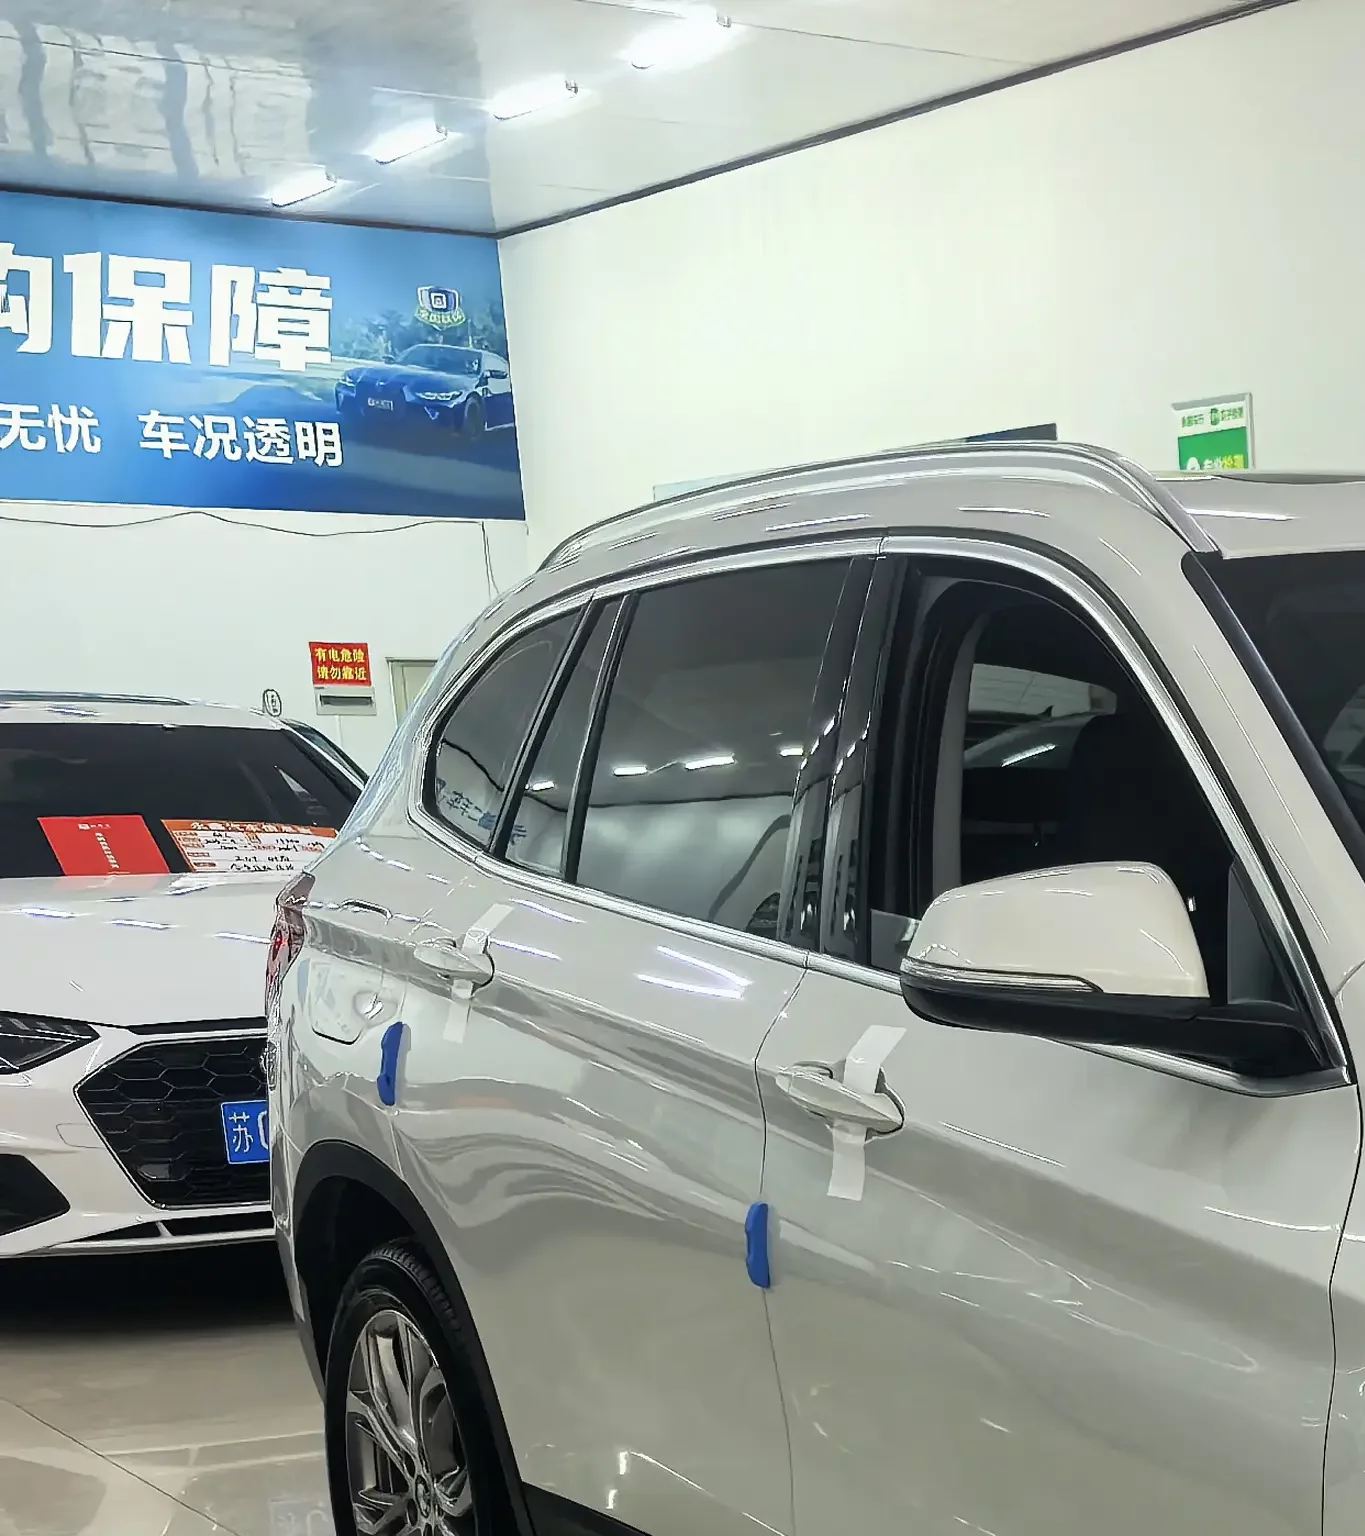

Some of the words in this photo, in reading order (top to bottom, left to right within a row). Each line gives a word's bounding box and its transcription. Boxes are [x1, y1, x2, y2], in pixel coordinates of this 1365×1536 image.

[137, 409, 345, 468] 车况透明
[314, 647, 365, 664] 有电危险
[317, 665, 368, 681] 请勿靠近
